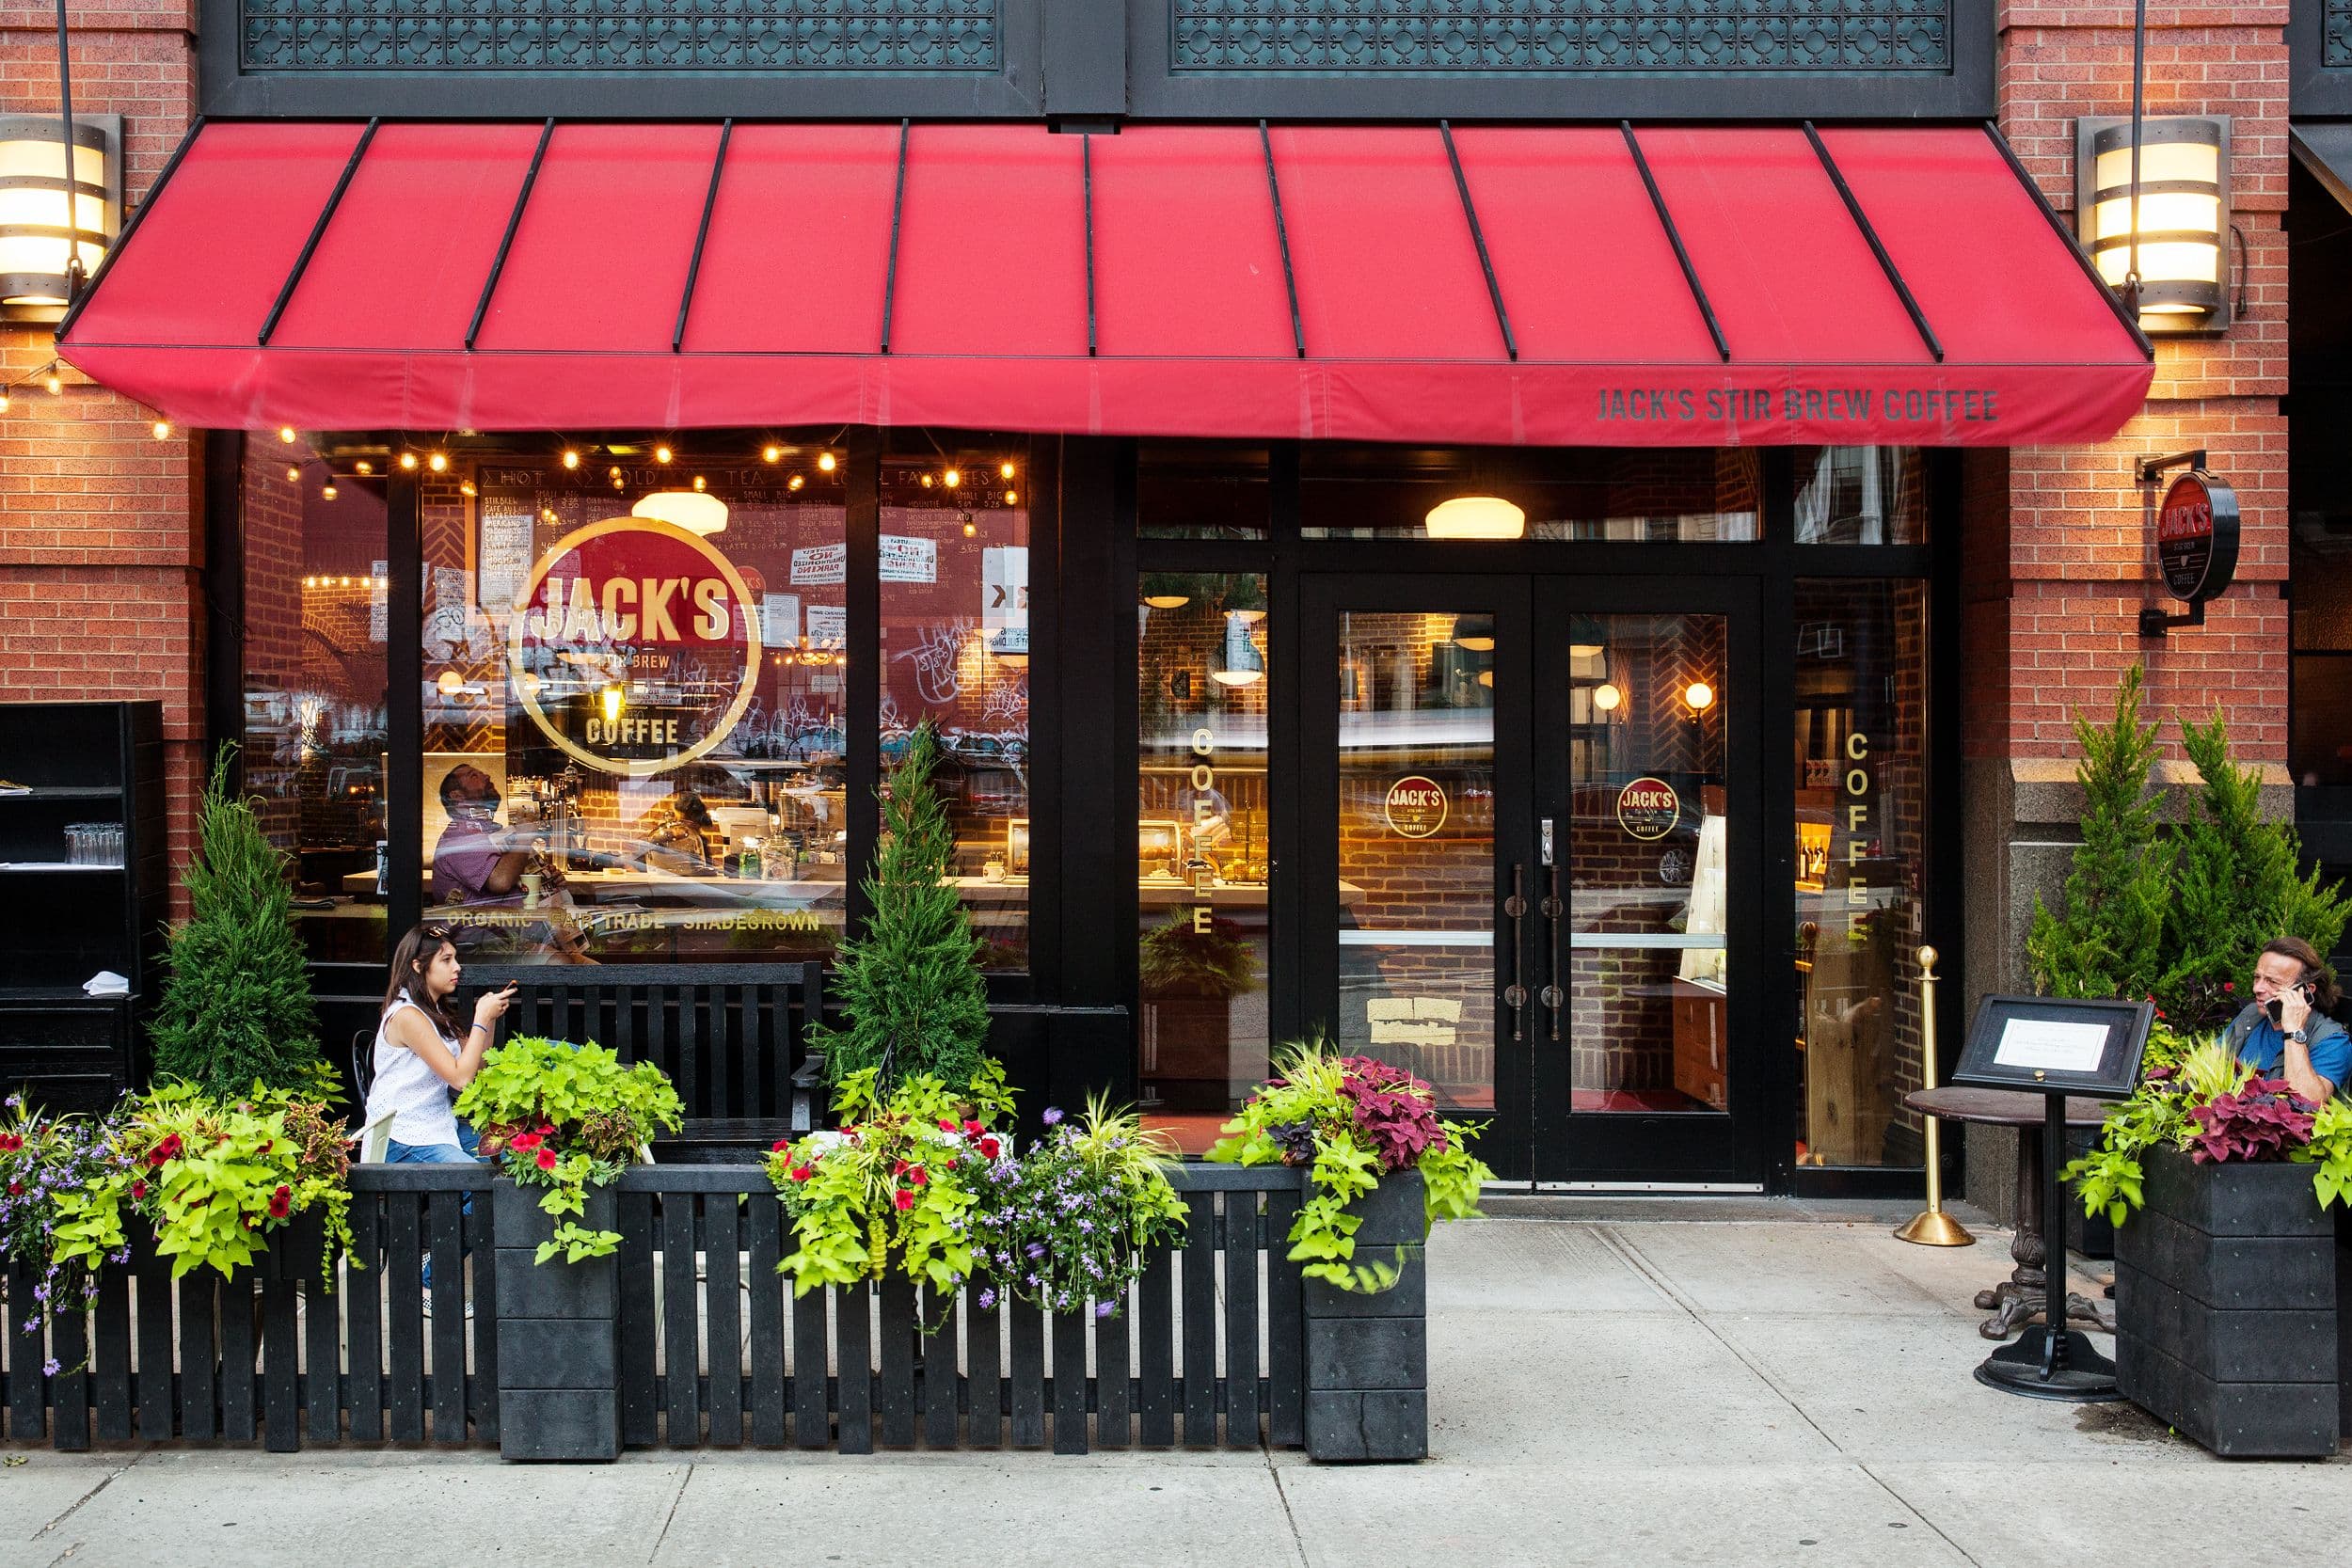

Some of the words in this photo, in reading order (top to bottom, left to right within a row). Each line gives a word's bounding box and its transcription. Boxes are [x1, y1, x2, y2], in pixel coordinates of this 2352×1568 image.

[1597, 388, 1694, 421] JACK'S
[1706, 388, 1772, 421] STIR
[1784, 388, 1873, 421] BREW
[1883, 388, 2000, 422] COFFEE
[501, 470, 545, 485] HOT
[608, 469, 656, 485] OLD
[725, 470, 765, 485] TEA
[2162, 502, 2208, 537] JACK'S
[2173, 573, 2195, 586] COFFEE
[529, 576, 731, 641] JACK'S
[632, 655, 670, 669] BREW
[585, 717, 679, 745] COFFEE
[1390, 789, 1440, 807] JACK'S
[1622, 791, 1673, 808] JACK'S
[1191, 727, 1215, 935] COFFEE
[1846, 732, 1869, 942] COFFEE
[446, 910, 533, 928] ORGANIC
[551, 911, 595, 929] FAIR
[603, 911, 666, 930] TRADE
[683, 912, 819, 931] SHADEGROWN
